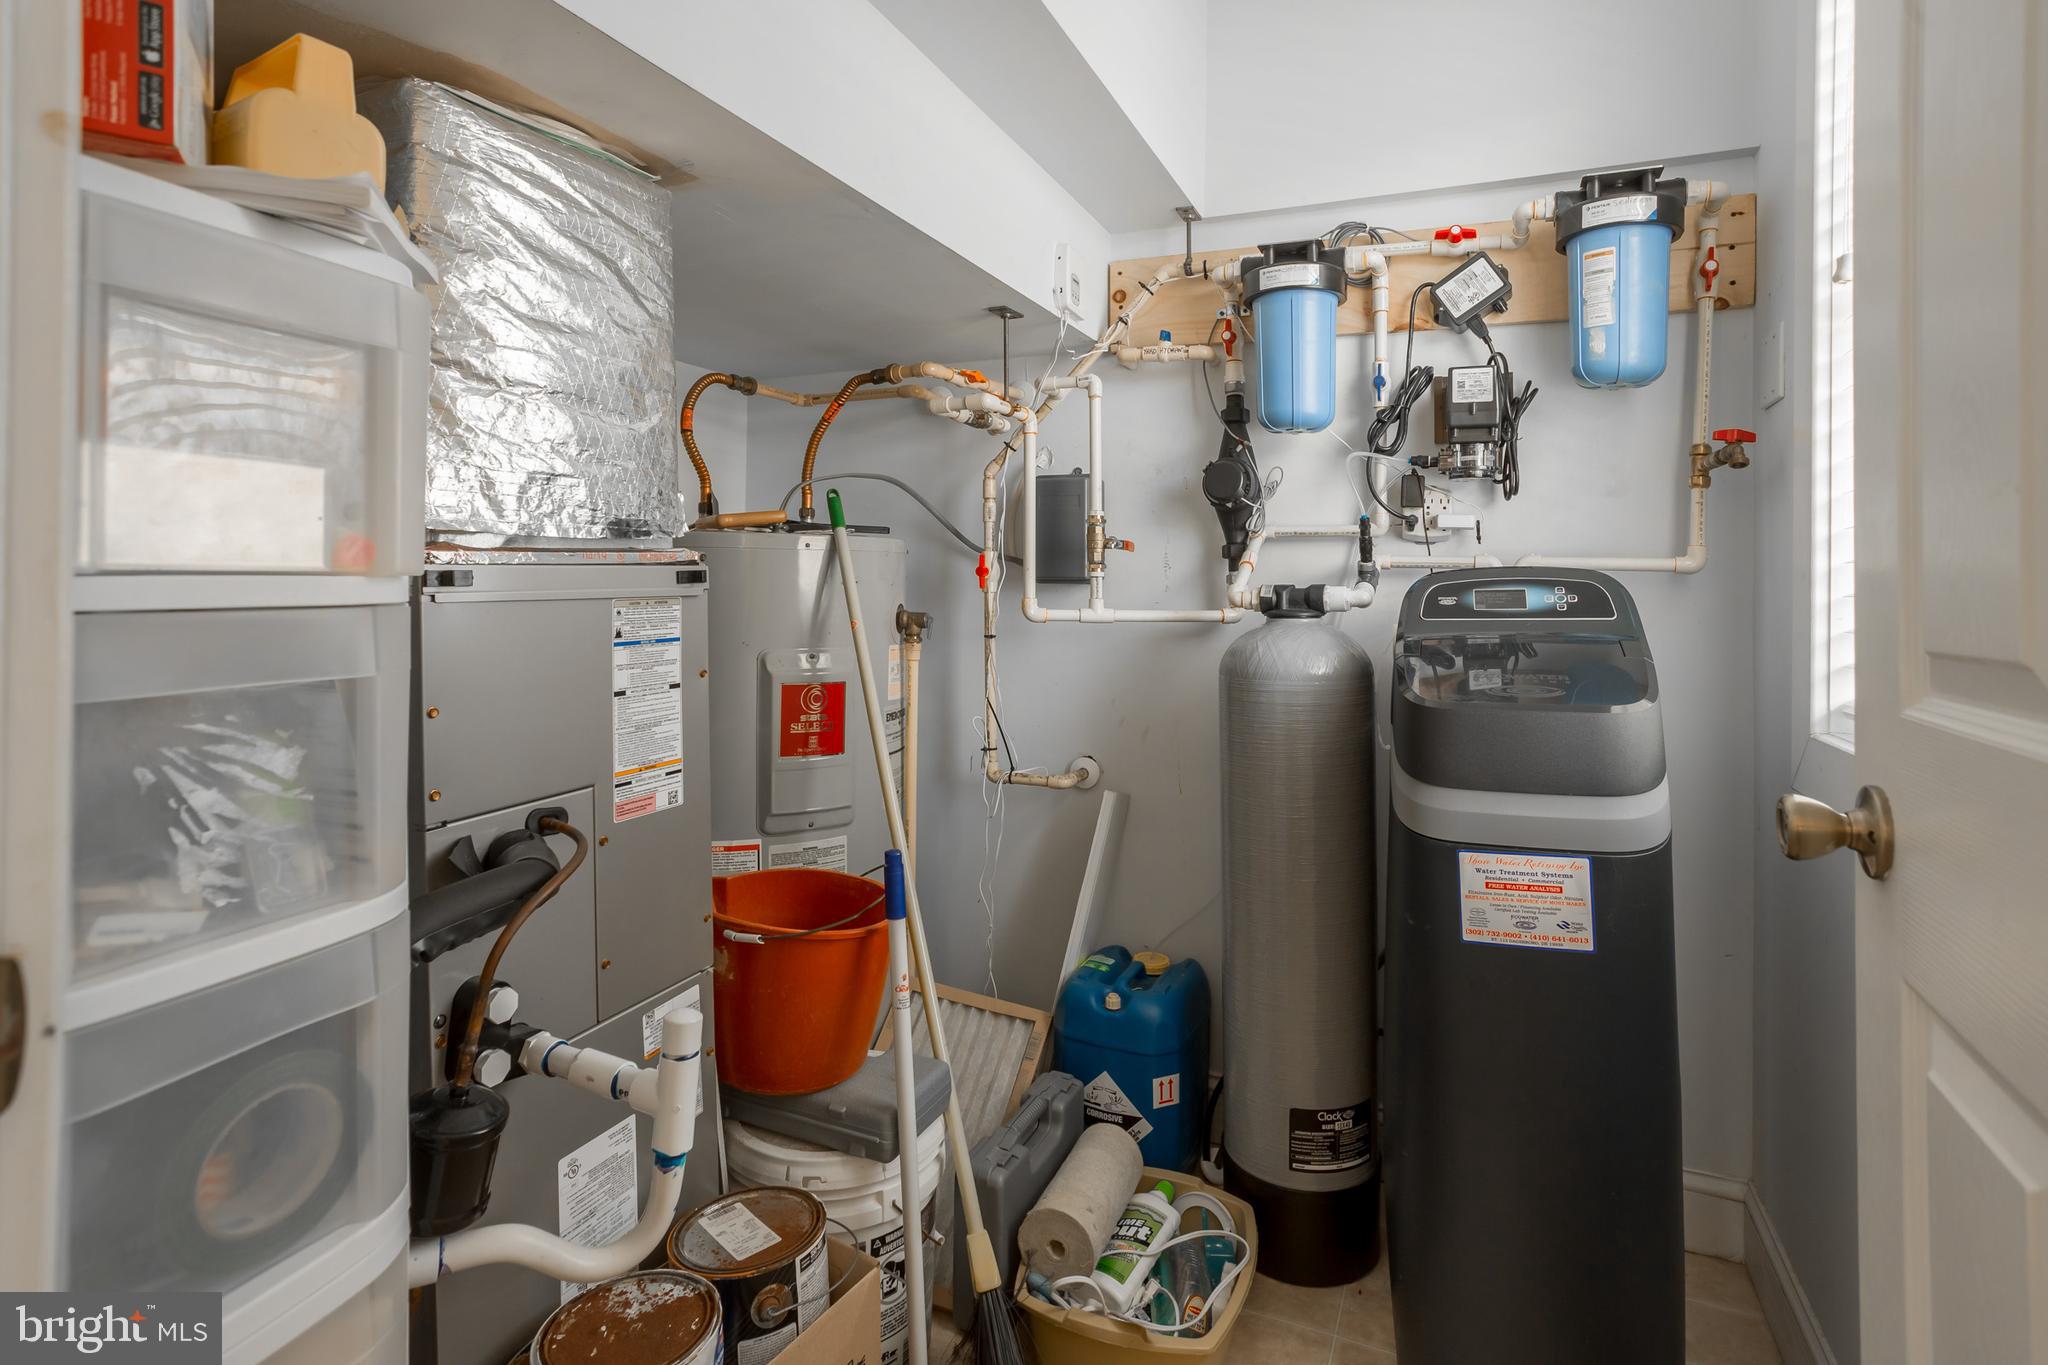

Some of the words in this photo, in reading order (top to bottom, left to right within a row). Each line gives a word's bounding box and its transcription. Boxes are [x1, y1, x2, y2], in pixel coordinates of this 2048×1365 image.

[1475, 867, 1497, 875] Water
[1499, 869, 1539, 877] Treatment
[1541, 871, 1574, 879] Systems
[1465, 928, 1485, 936] (302)
[1530, 933, 1550, 942] (410)
[1086, 1107, 1124, 1124] CORROSIVE
[1118, 1218, 1147, 1227] IME
